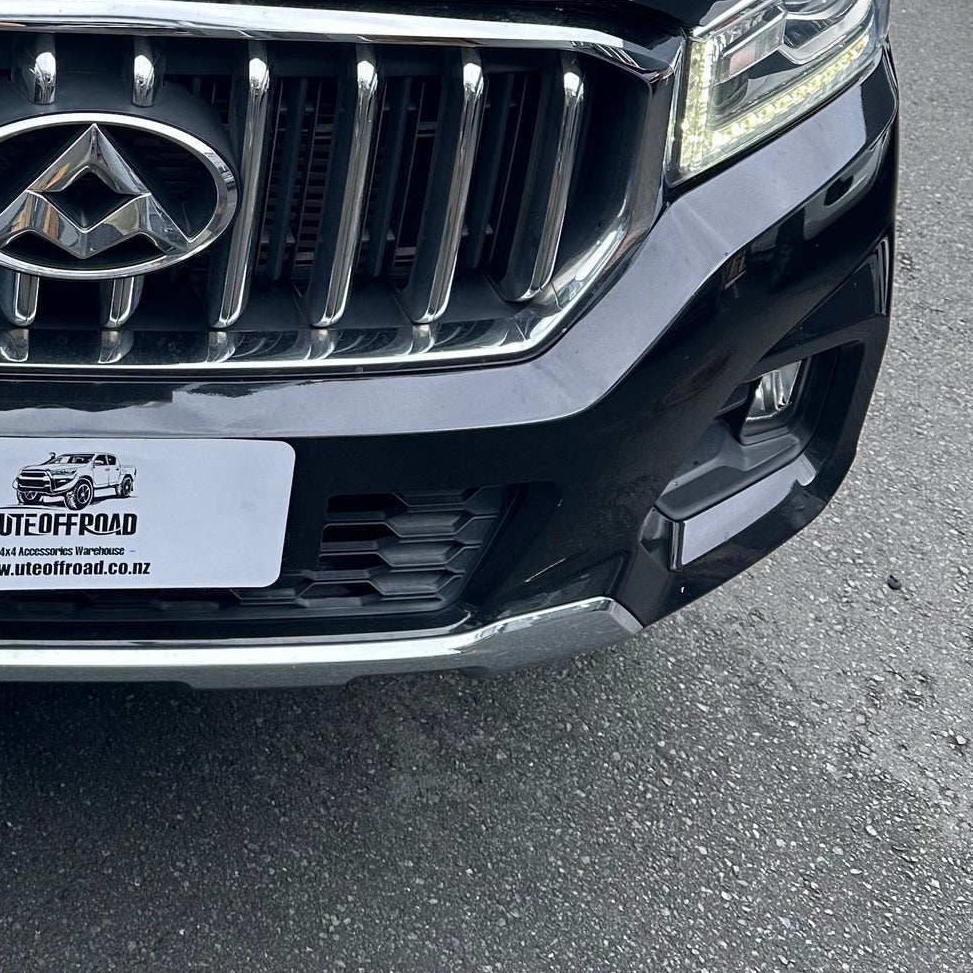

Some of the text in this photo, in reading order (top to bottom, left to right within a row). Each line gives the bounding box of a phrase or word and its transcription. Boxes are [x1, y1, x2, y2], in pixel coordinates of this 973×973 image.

[0, 546, 125, 557] 4x4 Accessories Warehouse
